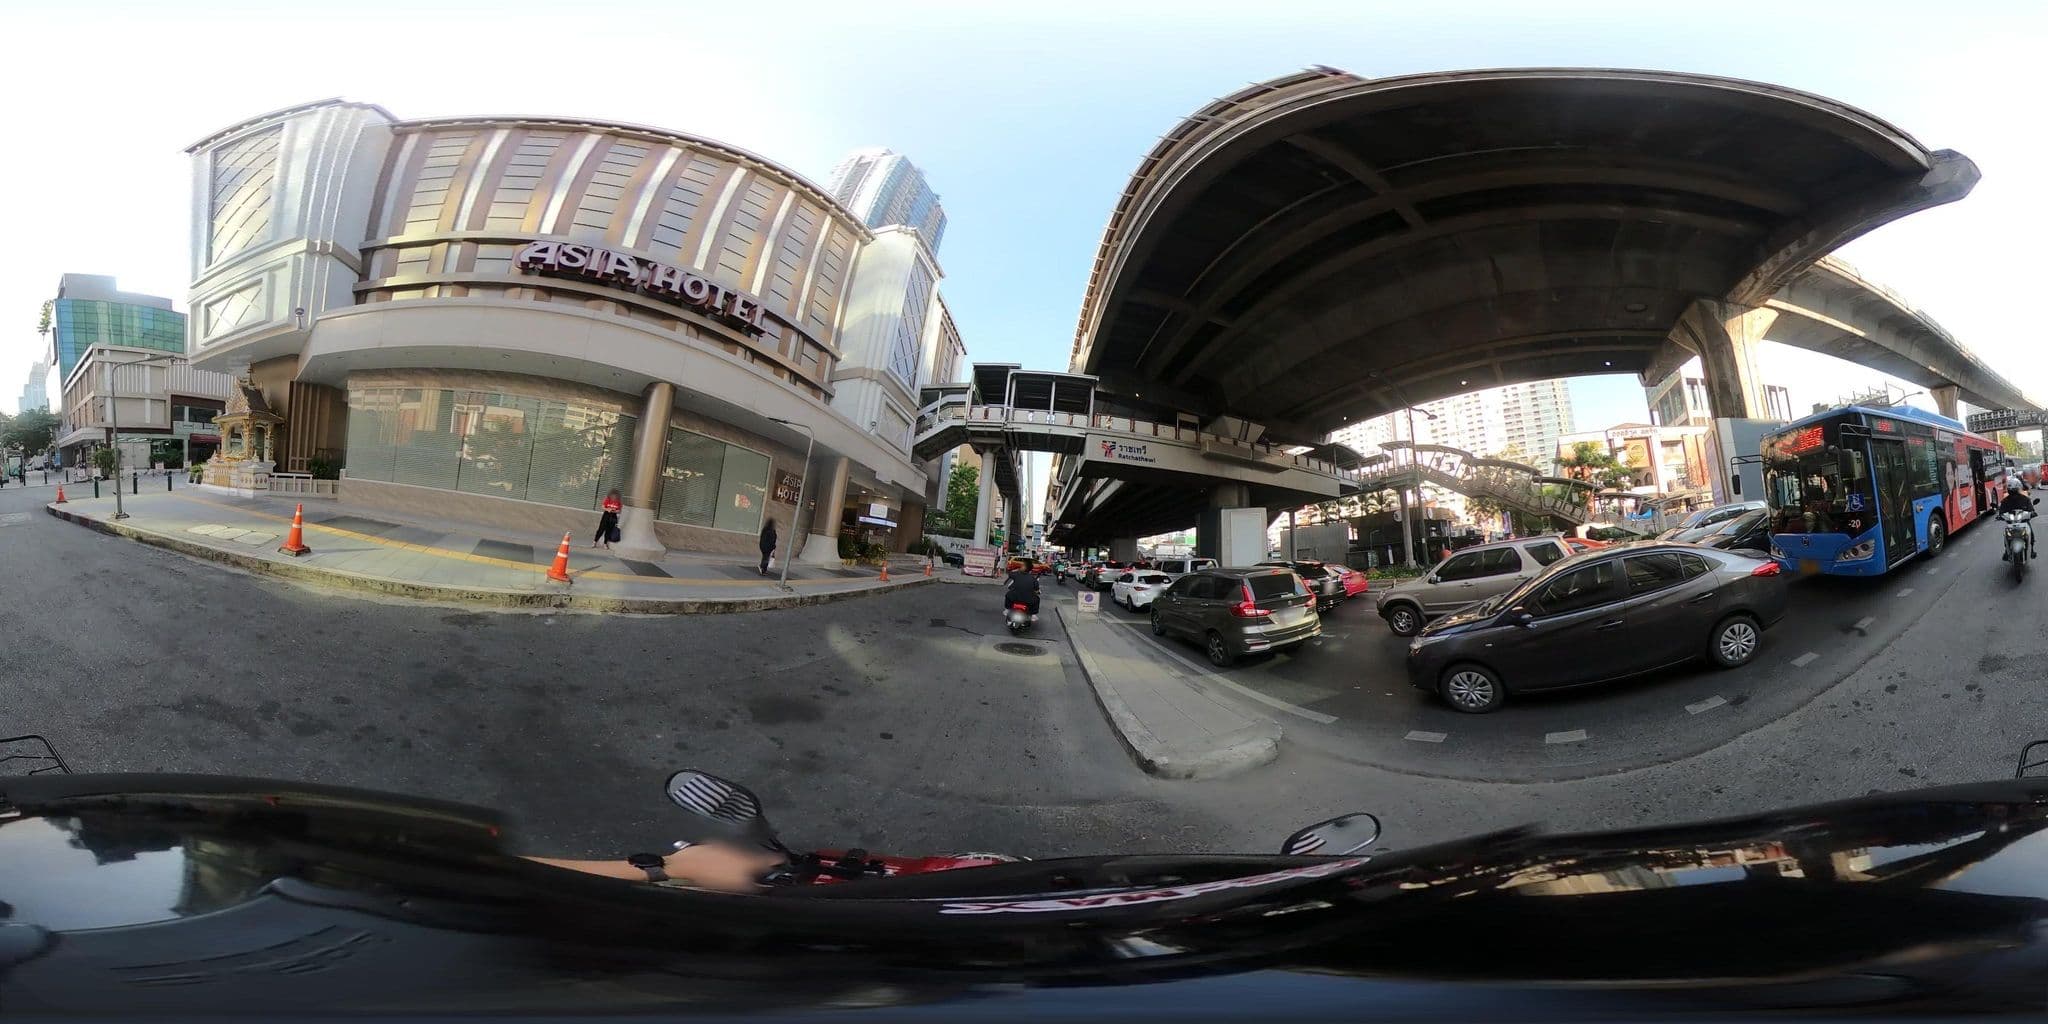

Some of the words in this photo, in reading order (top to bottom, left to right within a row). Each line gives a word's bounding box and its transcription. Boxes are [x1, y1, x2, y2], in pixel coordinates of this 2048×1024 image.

[515, 240, 642, 284] ASIA
[645, 261, 767, 337] HOTEL
[777, 487, 800, 502] HOTE
